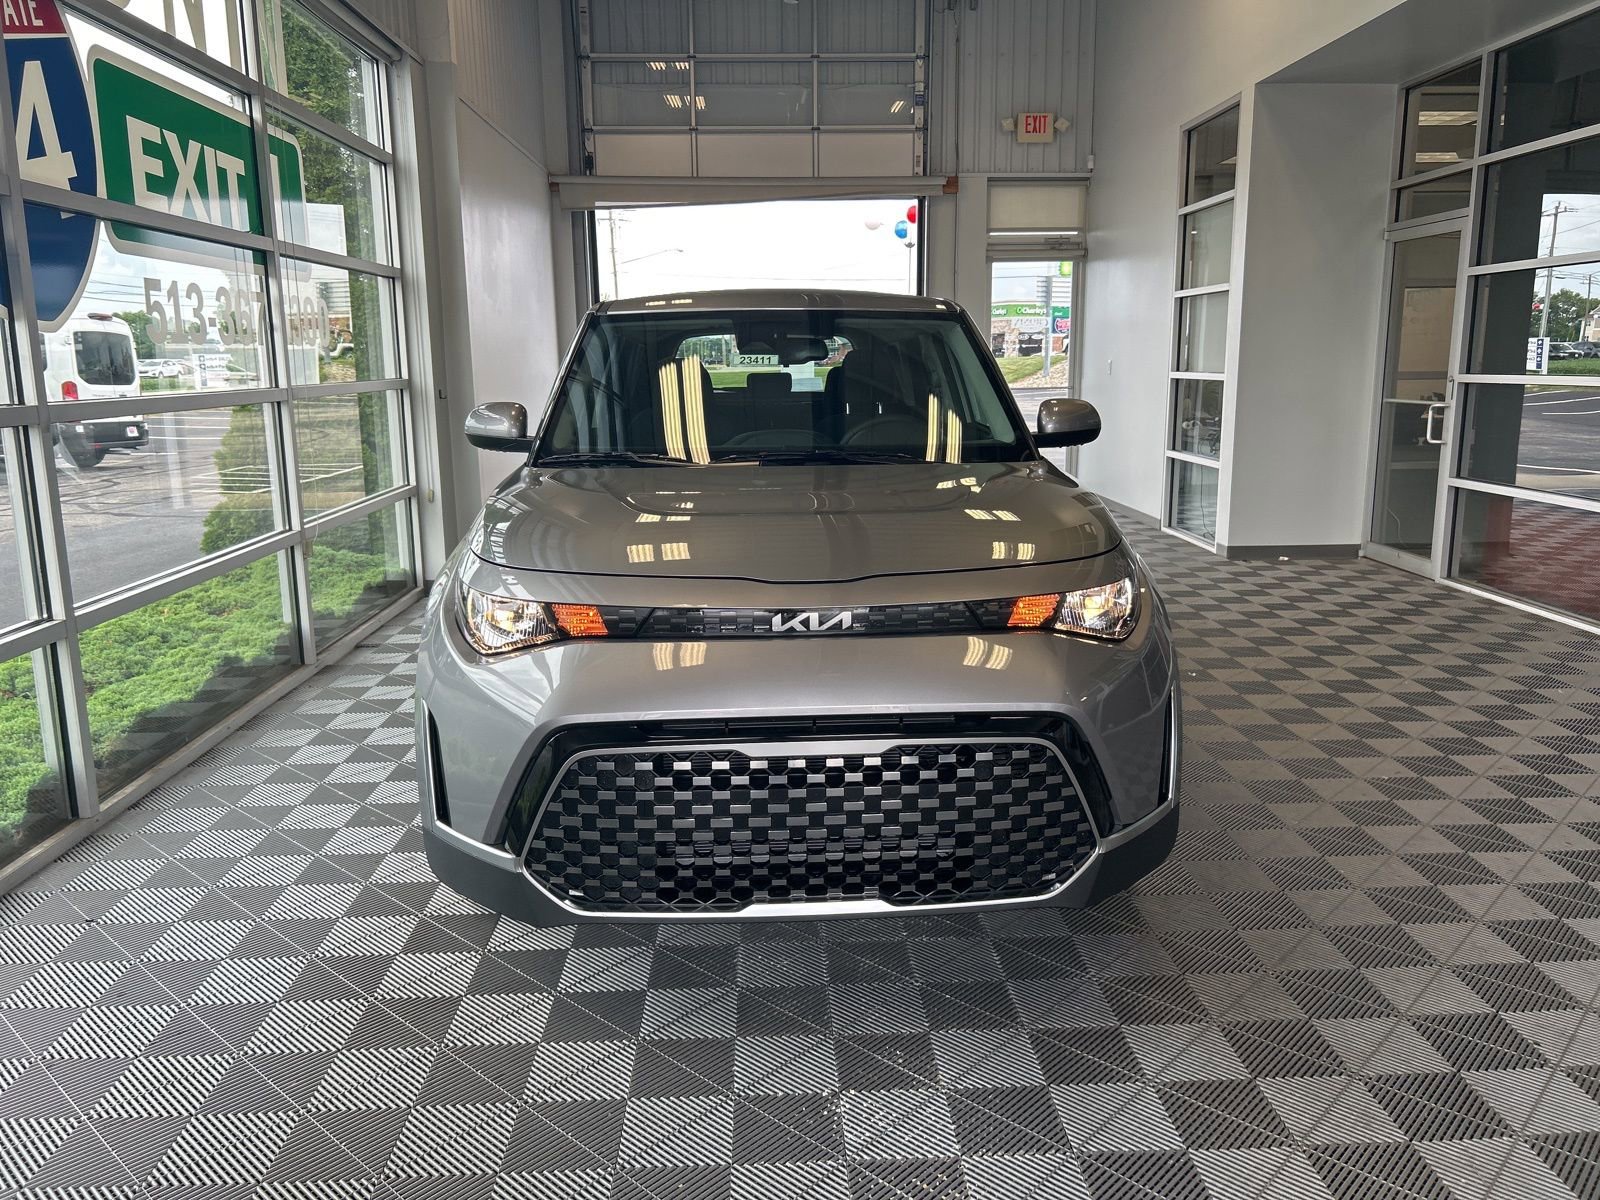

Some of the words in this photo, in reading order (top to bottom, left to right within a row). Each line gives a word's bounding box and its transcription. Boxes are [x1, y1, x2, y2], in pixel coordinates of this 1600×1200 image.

[1025, 115, 1048, 133] EXIT
[126, 115, 246, 231] EXIT
[740, 356, 771, 364] 23411
[772, 611, 851, 632] KIA
